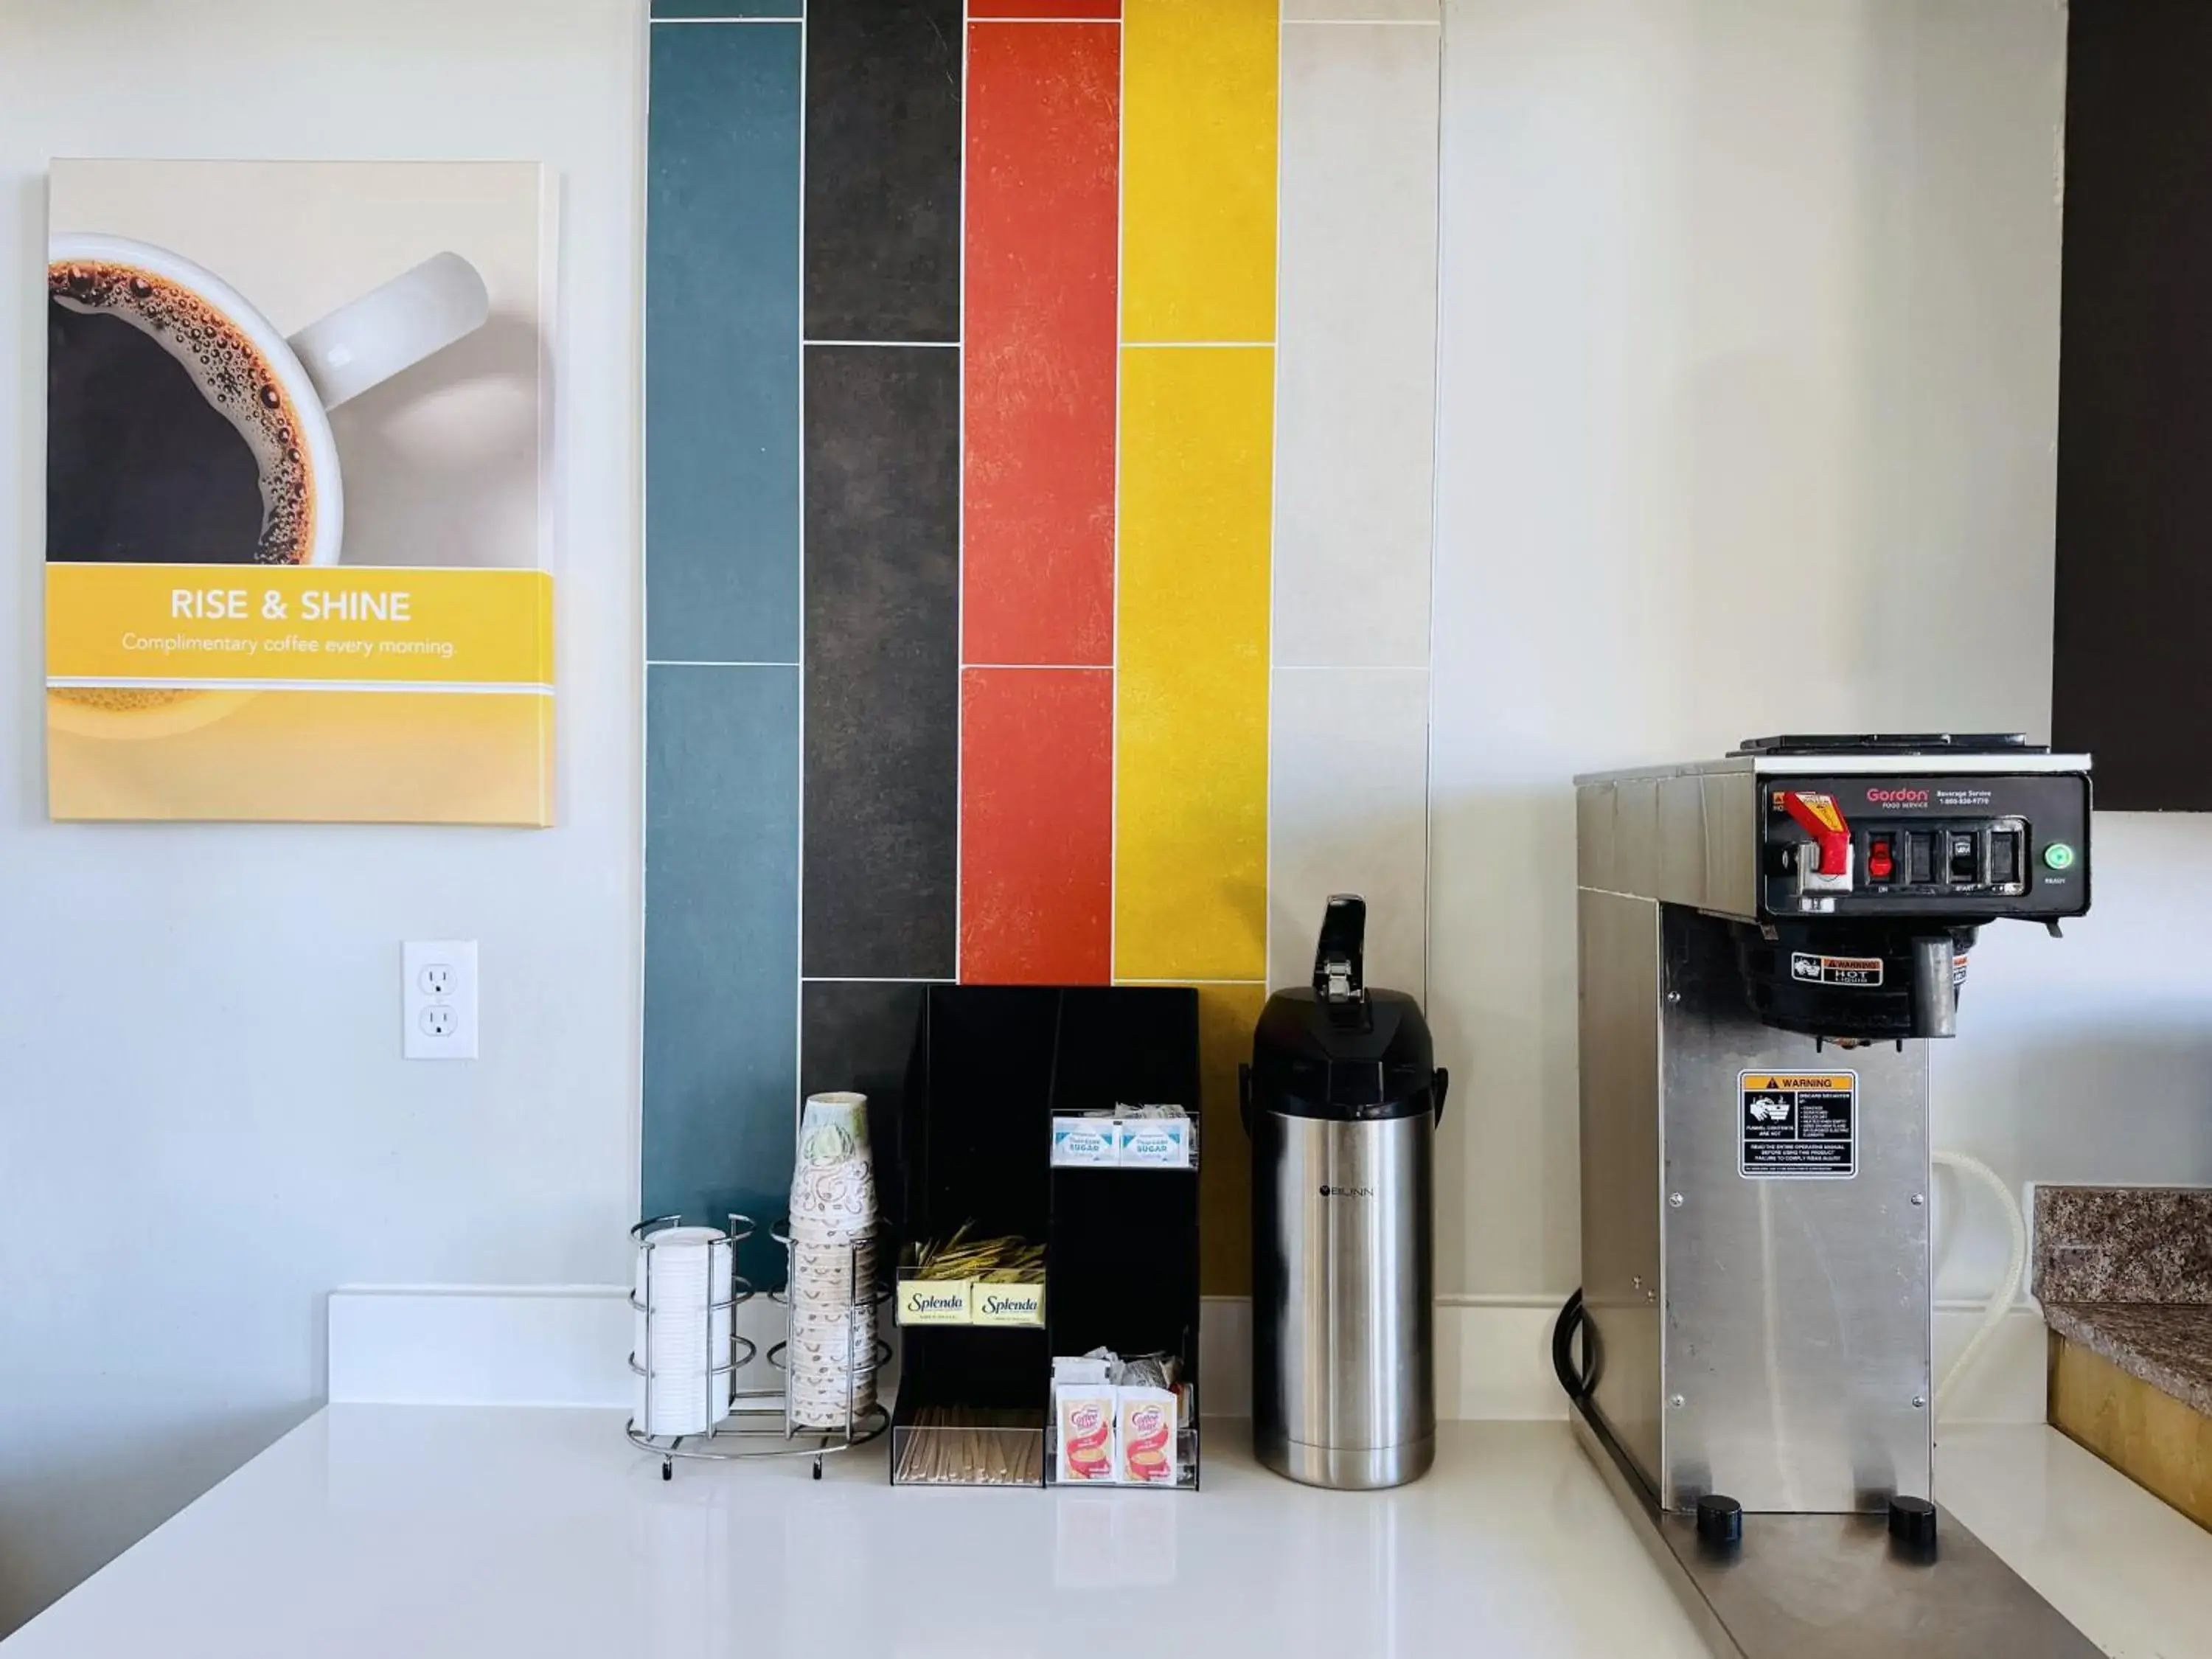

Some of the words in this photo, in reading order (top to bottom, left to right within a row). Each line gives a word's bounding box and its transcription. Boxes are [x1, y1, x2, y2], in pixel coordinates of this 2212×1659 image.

[171, 589, 248, 619] RISE
[262, 590, 288, 619] &
[301, 591, 411, 621] SHINE
[122, 632, 257, 655] Complimentary
[263, 635, 319, 653] coffee
[325, 639, 373, 657] every
[379, 638, 458, 658] morning.
[1867, 788, 1929, 801] Gordon
[1838, 960, 1877, 969] WARNING
[1835, 970, 1868, 978] HOT
[1782, 1079, 1832, 1088] WARNING
[1069, 1144, 1100, 1152] SUGAR
[1136, 1144, 1168, 1152] SUGAR
[908, 1293, 963, 1313] Splenda
[981, 1295, 1037, 1315] Splenda
